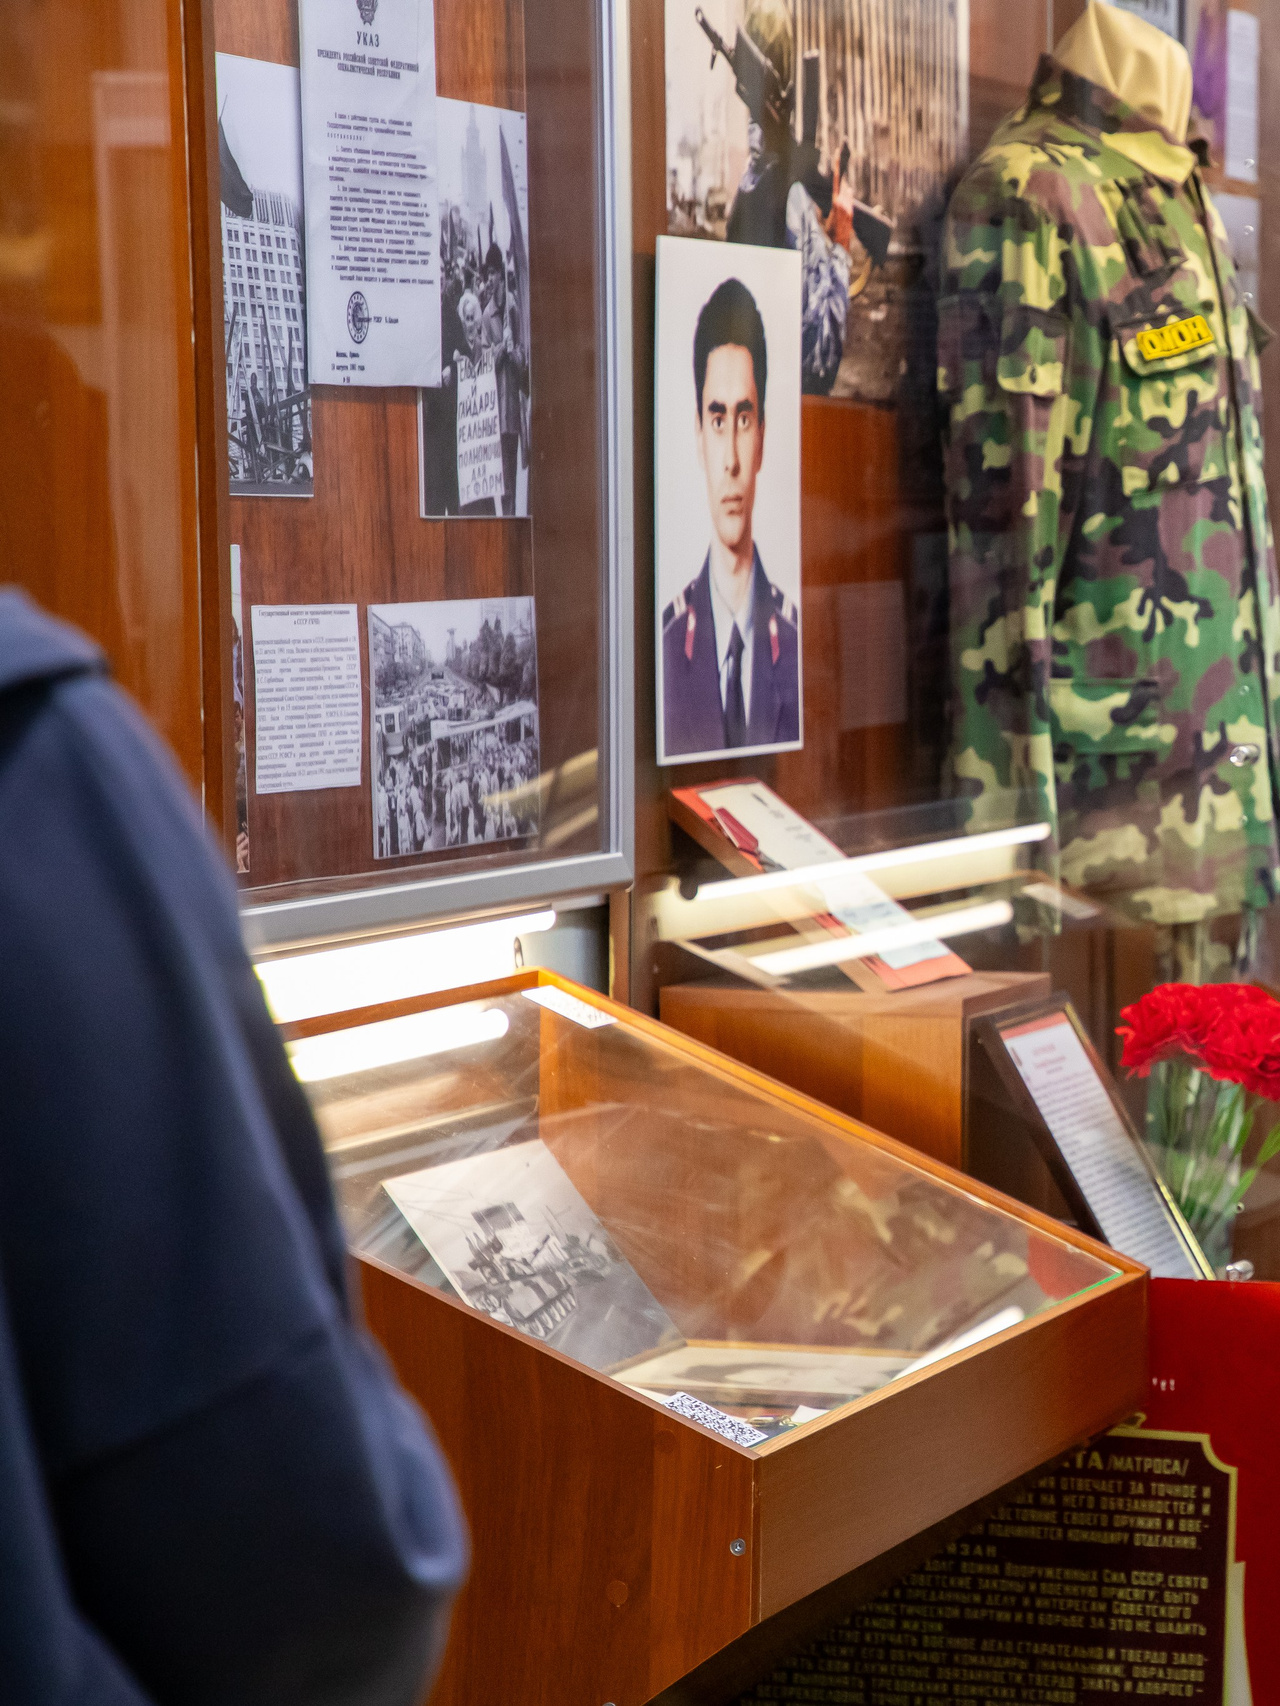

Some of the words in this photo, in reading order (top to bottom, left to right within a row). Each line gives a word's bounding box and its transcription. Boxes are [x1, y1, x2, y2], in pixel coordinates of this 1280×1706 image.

[357, 31, 380, 47] УКАЗ
[1142, 316, 1211, 354] ОМОН
[459, 389, 496, 420] ГАЙДАРУ
[459, 415, 498, 443] РЕАЛЬНЫЕ
[1106, 1454, 1189, 1477] /МАТРОСА/
[1060, 1477, 1122, 1493] ОТВЕЧАЕТ
[1129, 1481, 1144, 1494] ЗА
[1150, 1483, 1196, 1498] ТОЧНОЕ
[1202, 1486, 1211, 1499] И
[1040, 1492, 1056, 1506] НА
[1062, 1494, 1094, 1508] НЕГО
[1100, 1496, 1195, 1515] ОБЯЗАННОСТЕЙ
[1201, 1503, 1210, 1516] И
[1062, 1511, 1108, 1526] СВОЕГО
[1112, 1514, 1162, 1530] ОРУЖИЯ
[1166, 1518, 1174, 1530] И
[1066, 1529, 1129, 1544] КОМАНДИРУ
[1004, 1563, 1098, 1581] ВООРУЖЕННЫХ
[978, 1578, 1025, 1592] ЗАКОНЫ
[1028, 1582, 1036, 1593] И
[1163, 1590, 1198, 1603] БЫТЬ
[1022, 1596, 1030, 1608] И
[1112, 1602, 1192, 1618] СОВЕТСКОГО
[1109, 1617, 1133, 1630] ЭТО
[1154, 1620, 1206, 1635] ЩАДИТЬ
[1016, 1642, 1104, 1660] СТАРАТЕЛЬНО
[1106, 1648, 1116, 1660] И
[1120, 1649, 1168, 1664] ТВЕРДО
[1132, 1666, 1204, 1682] ОБРАЗЦОВО
[1081, 1678, 1120, 1692] ЗНАТЬ
[1123, 1681, 1132, 1693] И
